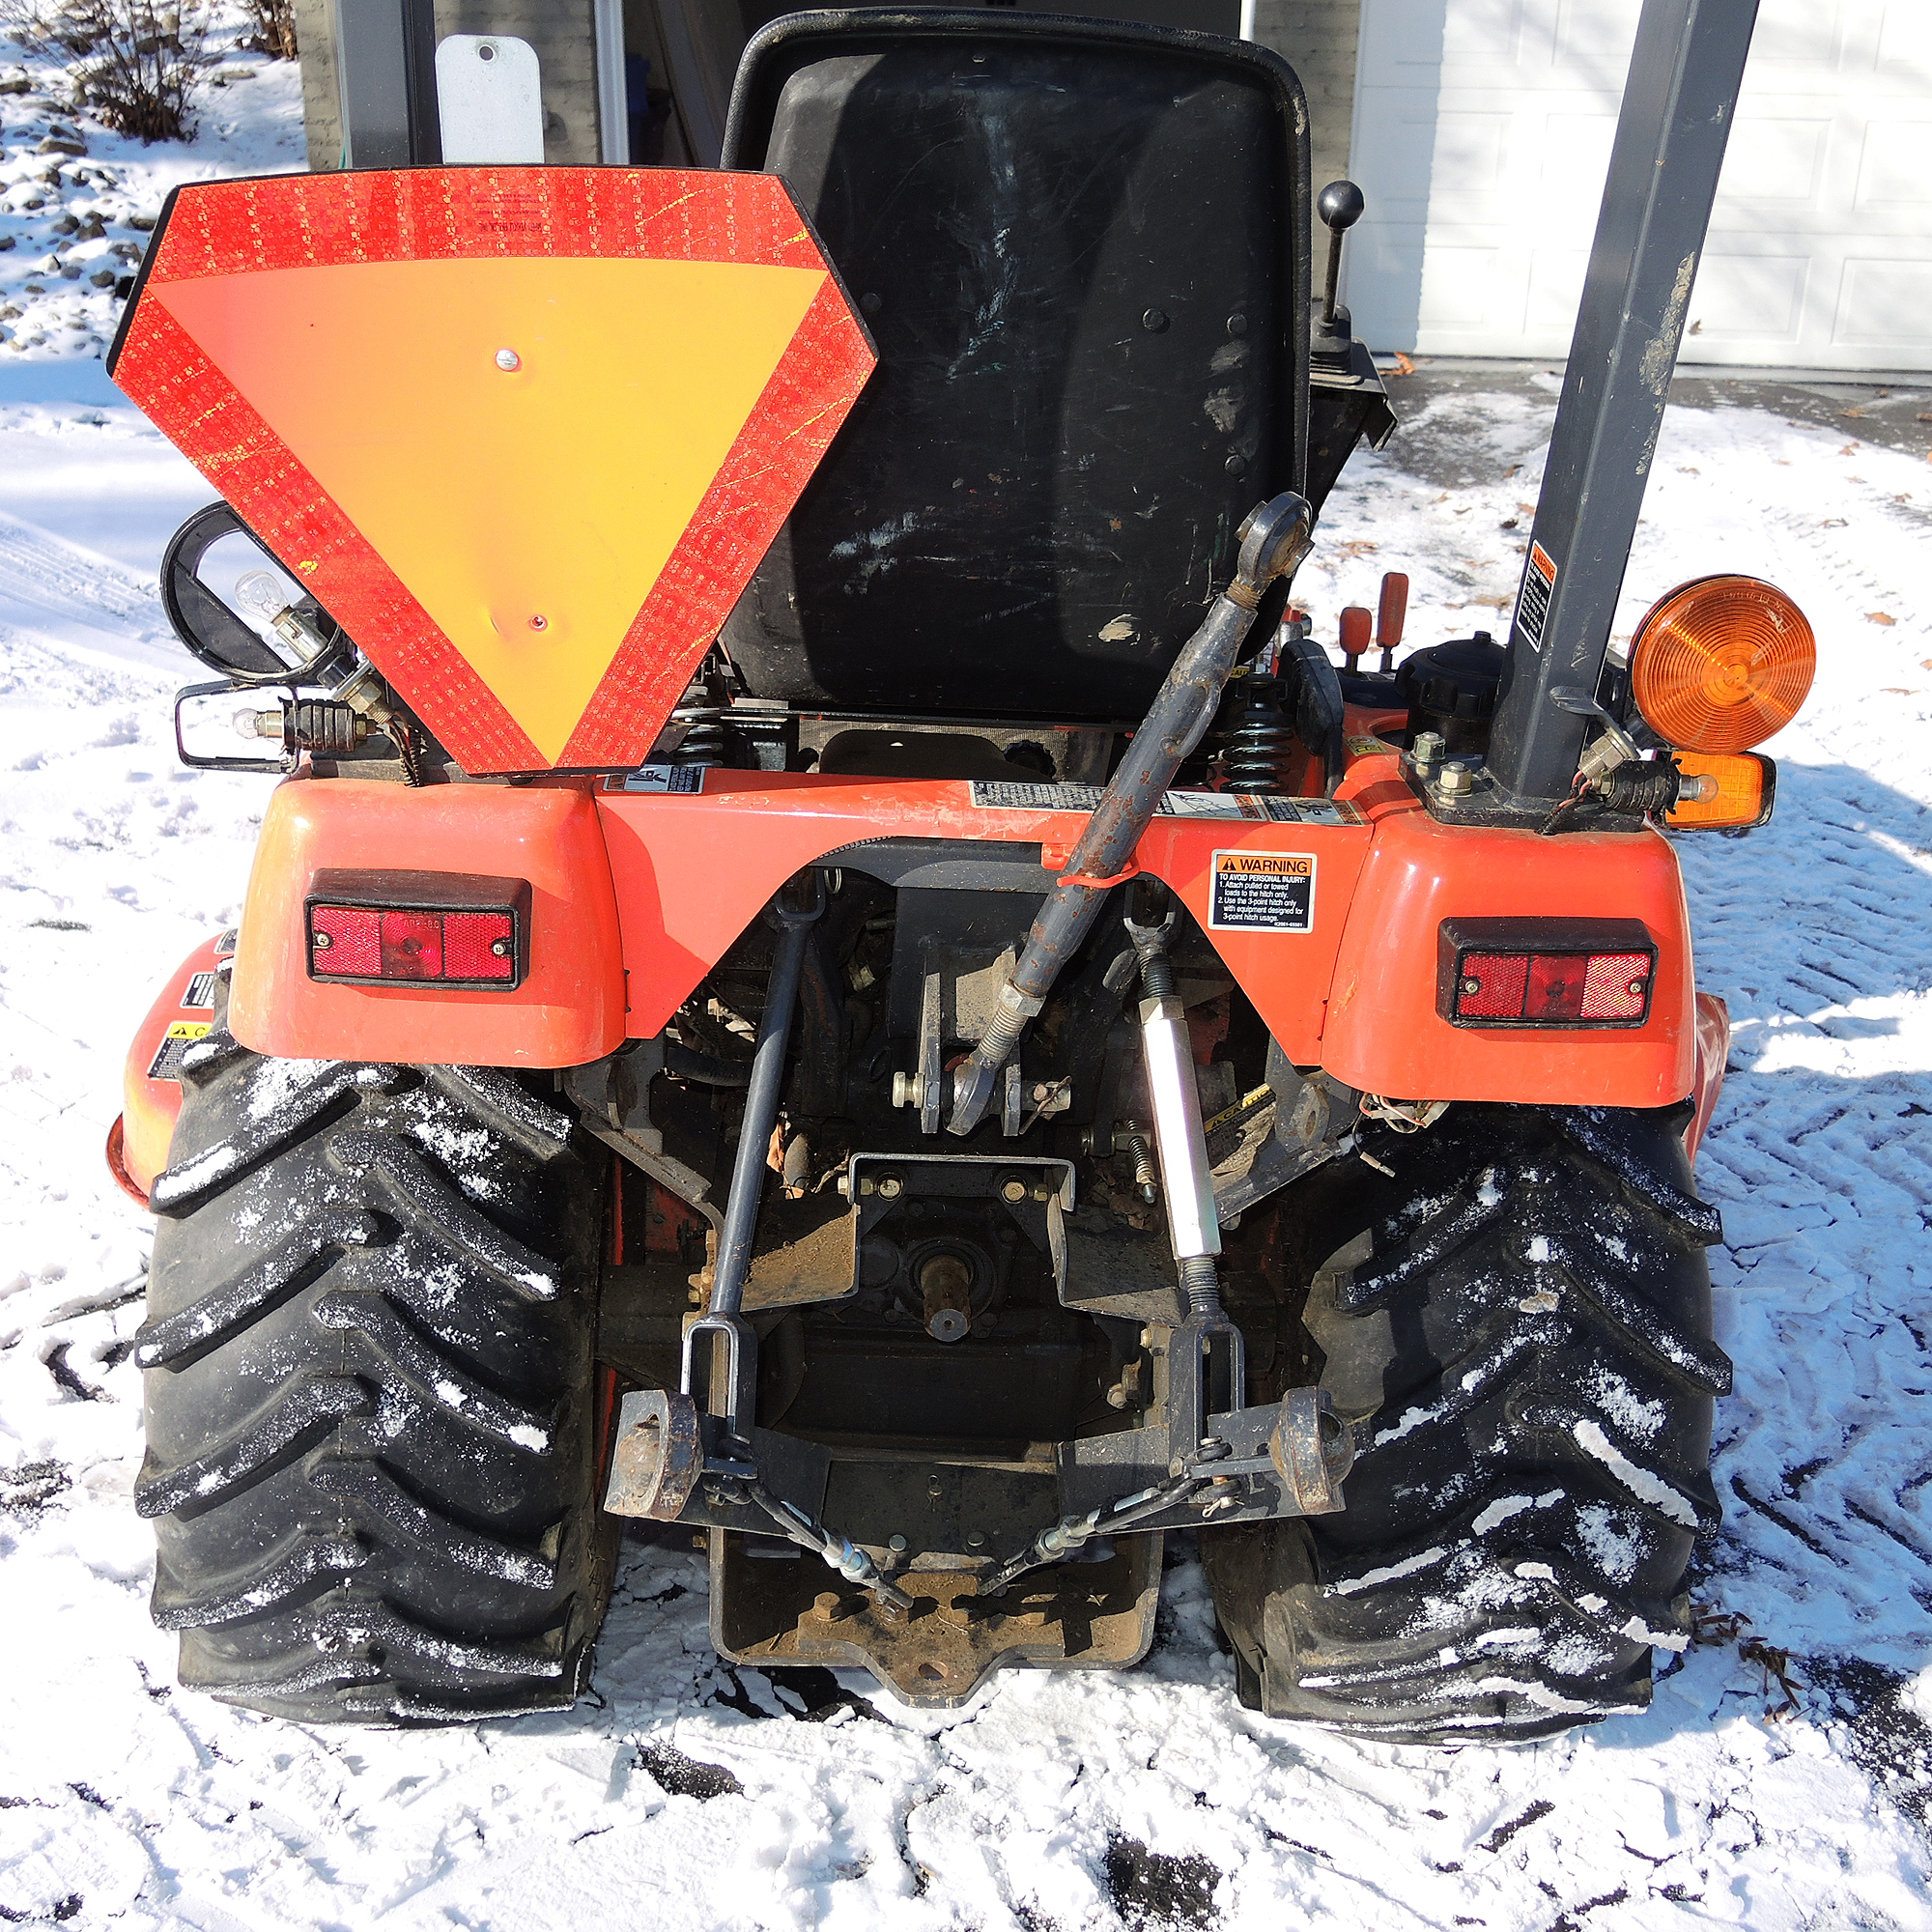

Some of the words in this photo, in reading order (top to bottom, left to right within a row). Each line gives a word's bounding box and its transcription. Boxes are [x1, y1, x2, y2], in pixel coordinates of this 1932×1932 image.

[1240, 859, 1307, 872] WARNING
[1247, 897, 1267, 906] 3-point
[1284, 899, 1297, 908] only
[1236, 906, 1266, 915] equipment
[1259, 915, 1279, 923] usage.
